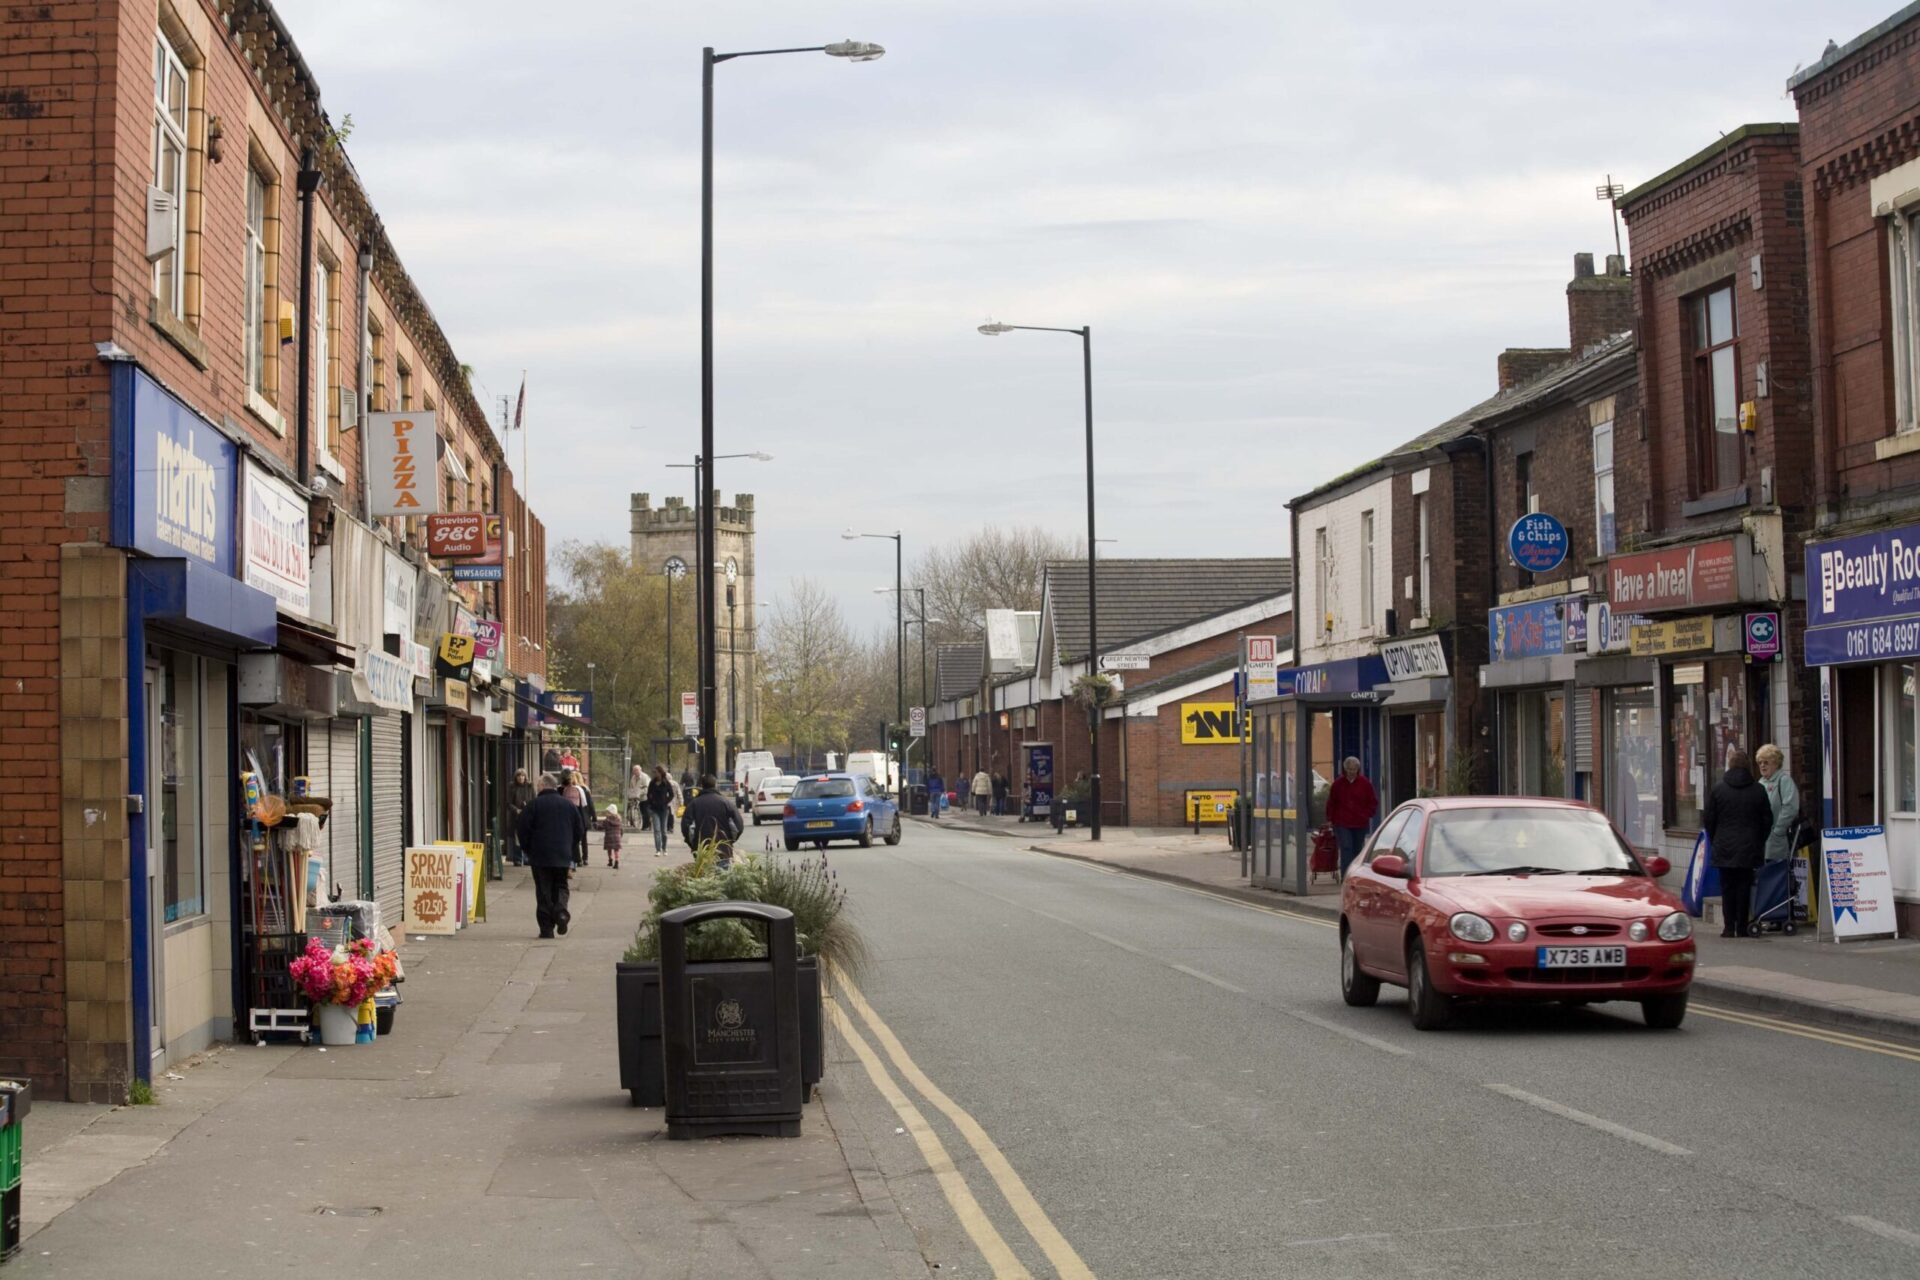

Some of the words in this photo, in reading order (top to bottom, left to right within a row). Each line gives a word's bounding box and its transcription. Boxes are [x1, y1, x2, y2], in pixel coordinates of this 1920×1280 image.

[392, 420, 421, 508] PIZZA
[434, 517, 478, 525] Television
[1526, 519, 1552, 530] Fish
[434, 526, 479, 542] G&C
[1518, 532, 1525, 541] &
[1527, 531, 1561, 544] Chips
[443, 544, 471, 552] Audio
[454, 568, 501, 578] NEWSAGENTS
[1834, 544, 1888, 595] Beauty
[1614, 569, 1644, 602] Have
[1647, 572, 1654, 599] a
[1675, 621, 1703, 633] Manchester
[1673, 635, 1691, 649] Evening
[1847, 629, 1869, 657] 0161
[1872, 626, 1892, 654] 684
[1894, 622, 1919, 652] 8997
[1385, 641, 1443, 676] OPTOMETRIST
[1351, 691, 1378, 699] GMPTE
[553, 704, 582, 717] HILL
[1825, 829, 1853, 837] BEAUTY
[1855, 827, 1881, 835] ROOMS
[411, 853, 453, 876] SPRAY
[410, 876, 452, 890] TANNING
[1548, 949, 1590, 965] X736
[1594, 948, 1623, 963] AWB
[707, 1028, 756, 1037] MANCHESTER
